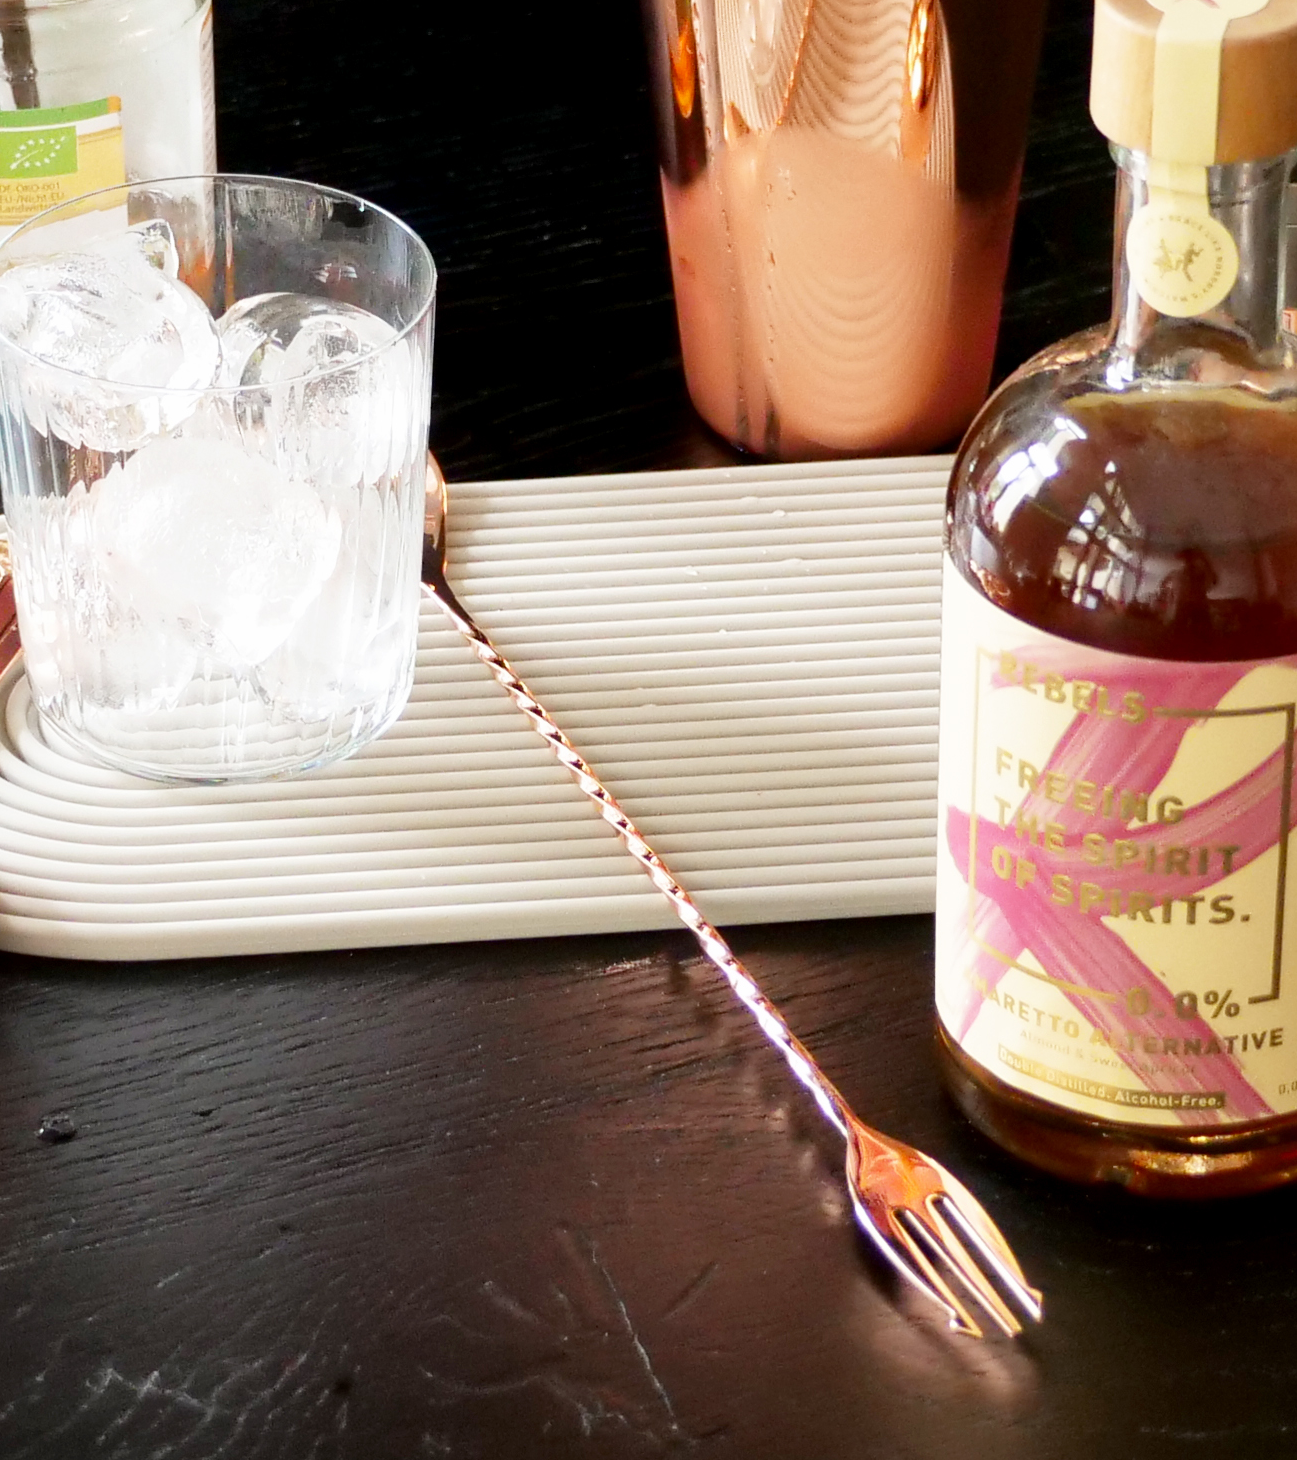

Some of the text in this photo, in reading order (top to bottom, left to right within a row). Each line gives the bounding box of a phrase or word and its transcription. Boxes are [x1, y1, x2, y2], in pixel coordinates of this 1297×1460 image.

[999, 649, 1148, 724] REBELS
[995, 747, 1185, 825] FREEING
[993, 796, 1241, 878] THE SPIRIT
[990, 844, 1252, 926] OF SPIRITS.
[1125, 987, 1241, 1021] 0.0%
[999, 1047, 1222, 1109] Double Distilled. Alcohol-Free.
[1089, 1026, 1285, 1060] ATERNATIVE
